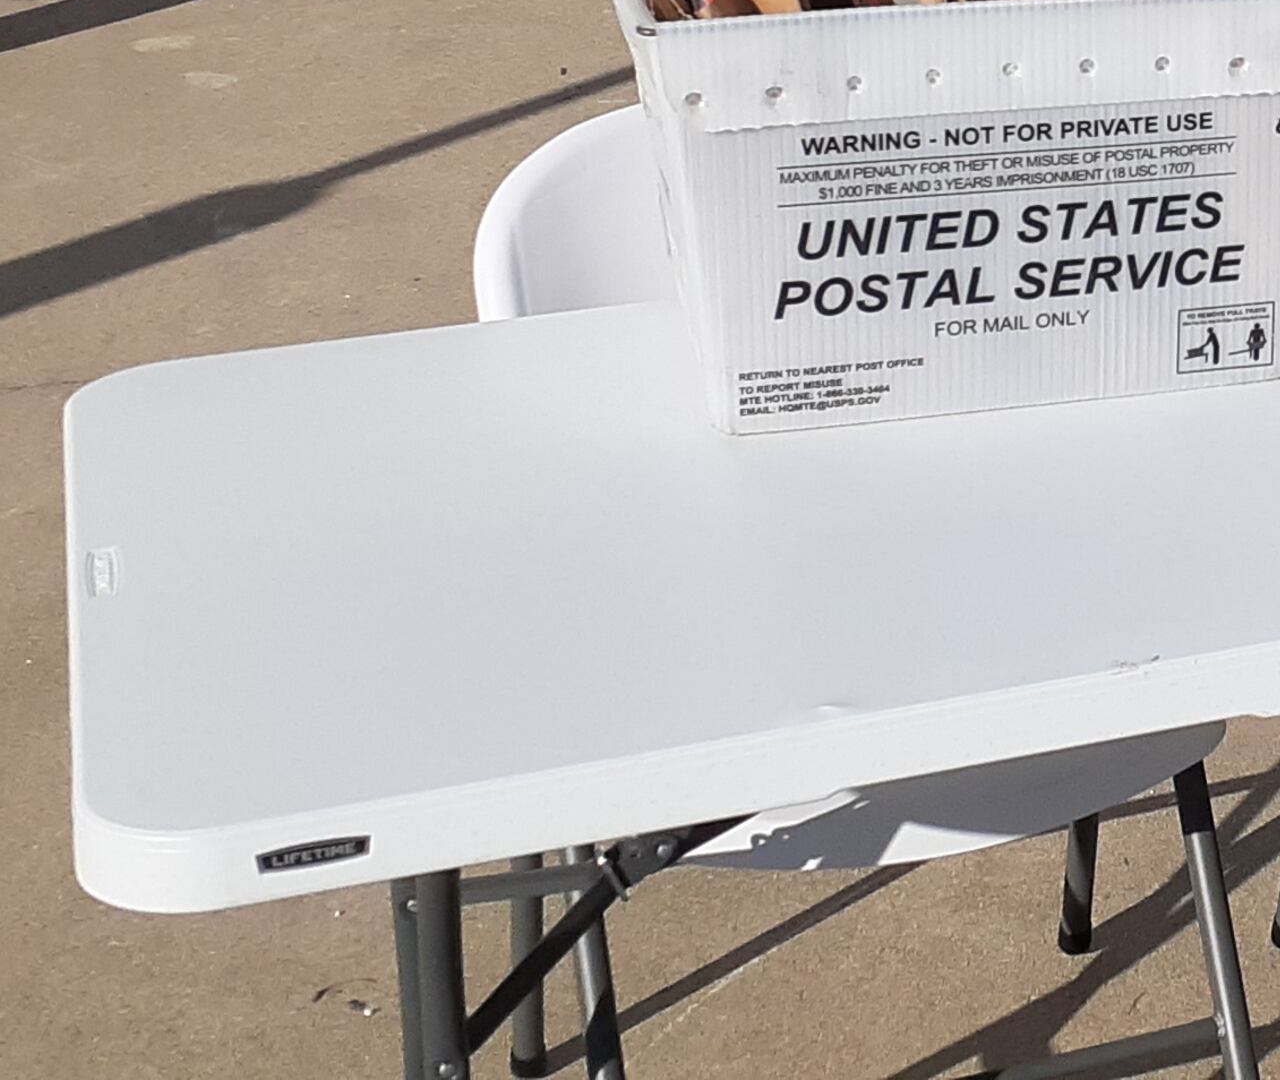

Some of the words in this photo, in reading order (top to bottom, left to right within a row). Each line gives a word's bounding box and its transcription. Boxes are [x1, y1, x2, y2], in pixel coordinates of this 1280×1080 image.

[801, 131, 921, 156] WARNING
[944, 126, 995, 147] NOT
[1003, 123, 1053, 143] FOR
[1060, 116, 1159, 139] PRIVATE
[1167, 112, 1213, 132] USE
[780, 169, 850, 185] MAXIMUM
[853, 164, 917, 179] PENALTY
[920, 161, 951, 175] FOR
[954, 158, 998, 172] THEFT
[1002, 156, 1023, 169] OR
[1026, 153, 1079, 168] MISUSE
[1082, 151, 1102, 164] OF
[1105, 148, 1157, 162] POSTAL
[1160, 142, 1234, 159] PROPERTY
[819, 186, 863, 201] $1,000
[865, 182, 897, 196] FINE
[900, 180, 931, 194] AND
[934, 179, 942, 191] 3
[945, 176, 992, 190] YEARS
[996, 169, 1103, 187] IMPRISONMENT
[1106, 165, 1125, 181] (18
[1129, 164, 1158, 178] USC
[1161, 162, 1195, 176] 1707)
[797, 209, 1000, 260] UNITED
[1017, 191, 1223, 243] STATES
[774, 267, 995, 320] POSTAL
[1014, 244, 1245, 300] SERVICE
[934, 319, 977, 337] FOR
[983, 315, 1030, 333] MAIL
[1035, 309, 1090, 328] ONLY
[738, 370, 783, 382] RETURN
[785, 369, 800, 378] TO
[803, 364, 854, 377] NEAREST
[855, 361, 885, 371] POST
[886, 357, 925, 369] OFFICE
[739, 385, 754, 395] TO
[756, 381, 800, 393] REPORT
[803, 378, 843, 390] MISUSE
[739, 396, 762, 406] MTE
[764, 391, 814, 404] HOTLINE:
[739, 406, 776, 417] EMAIL:
[271, 841, 357, 867] LIFETIME
